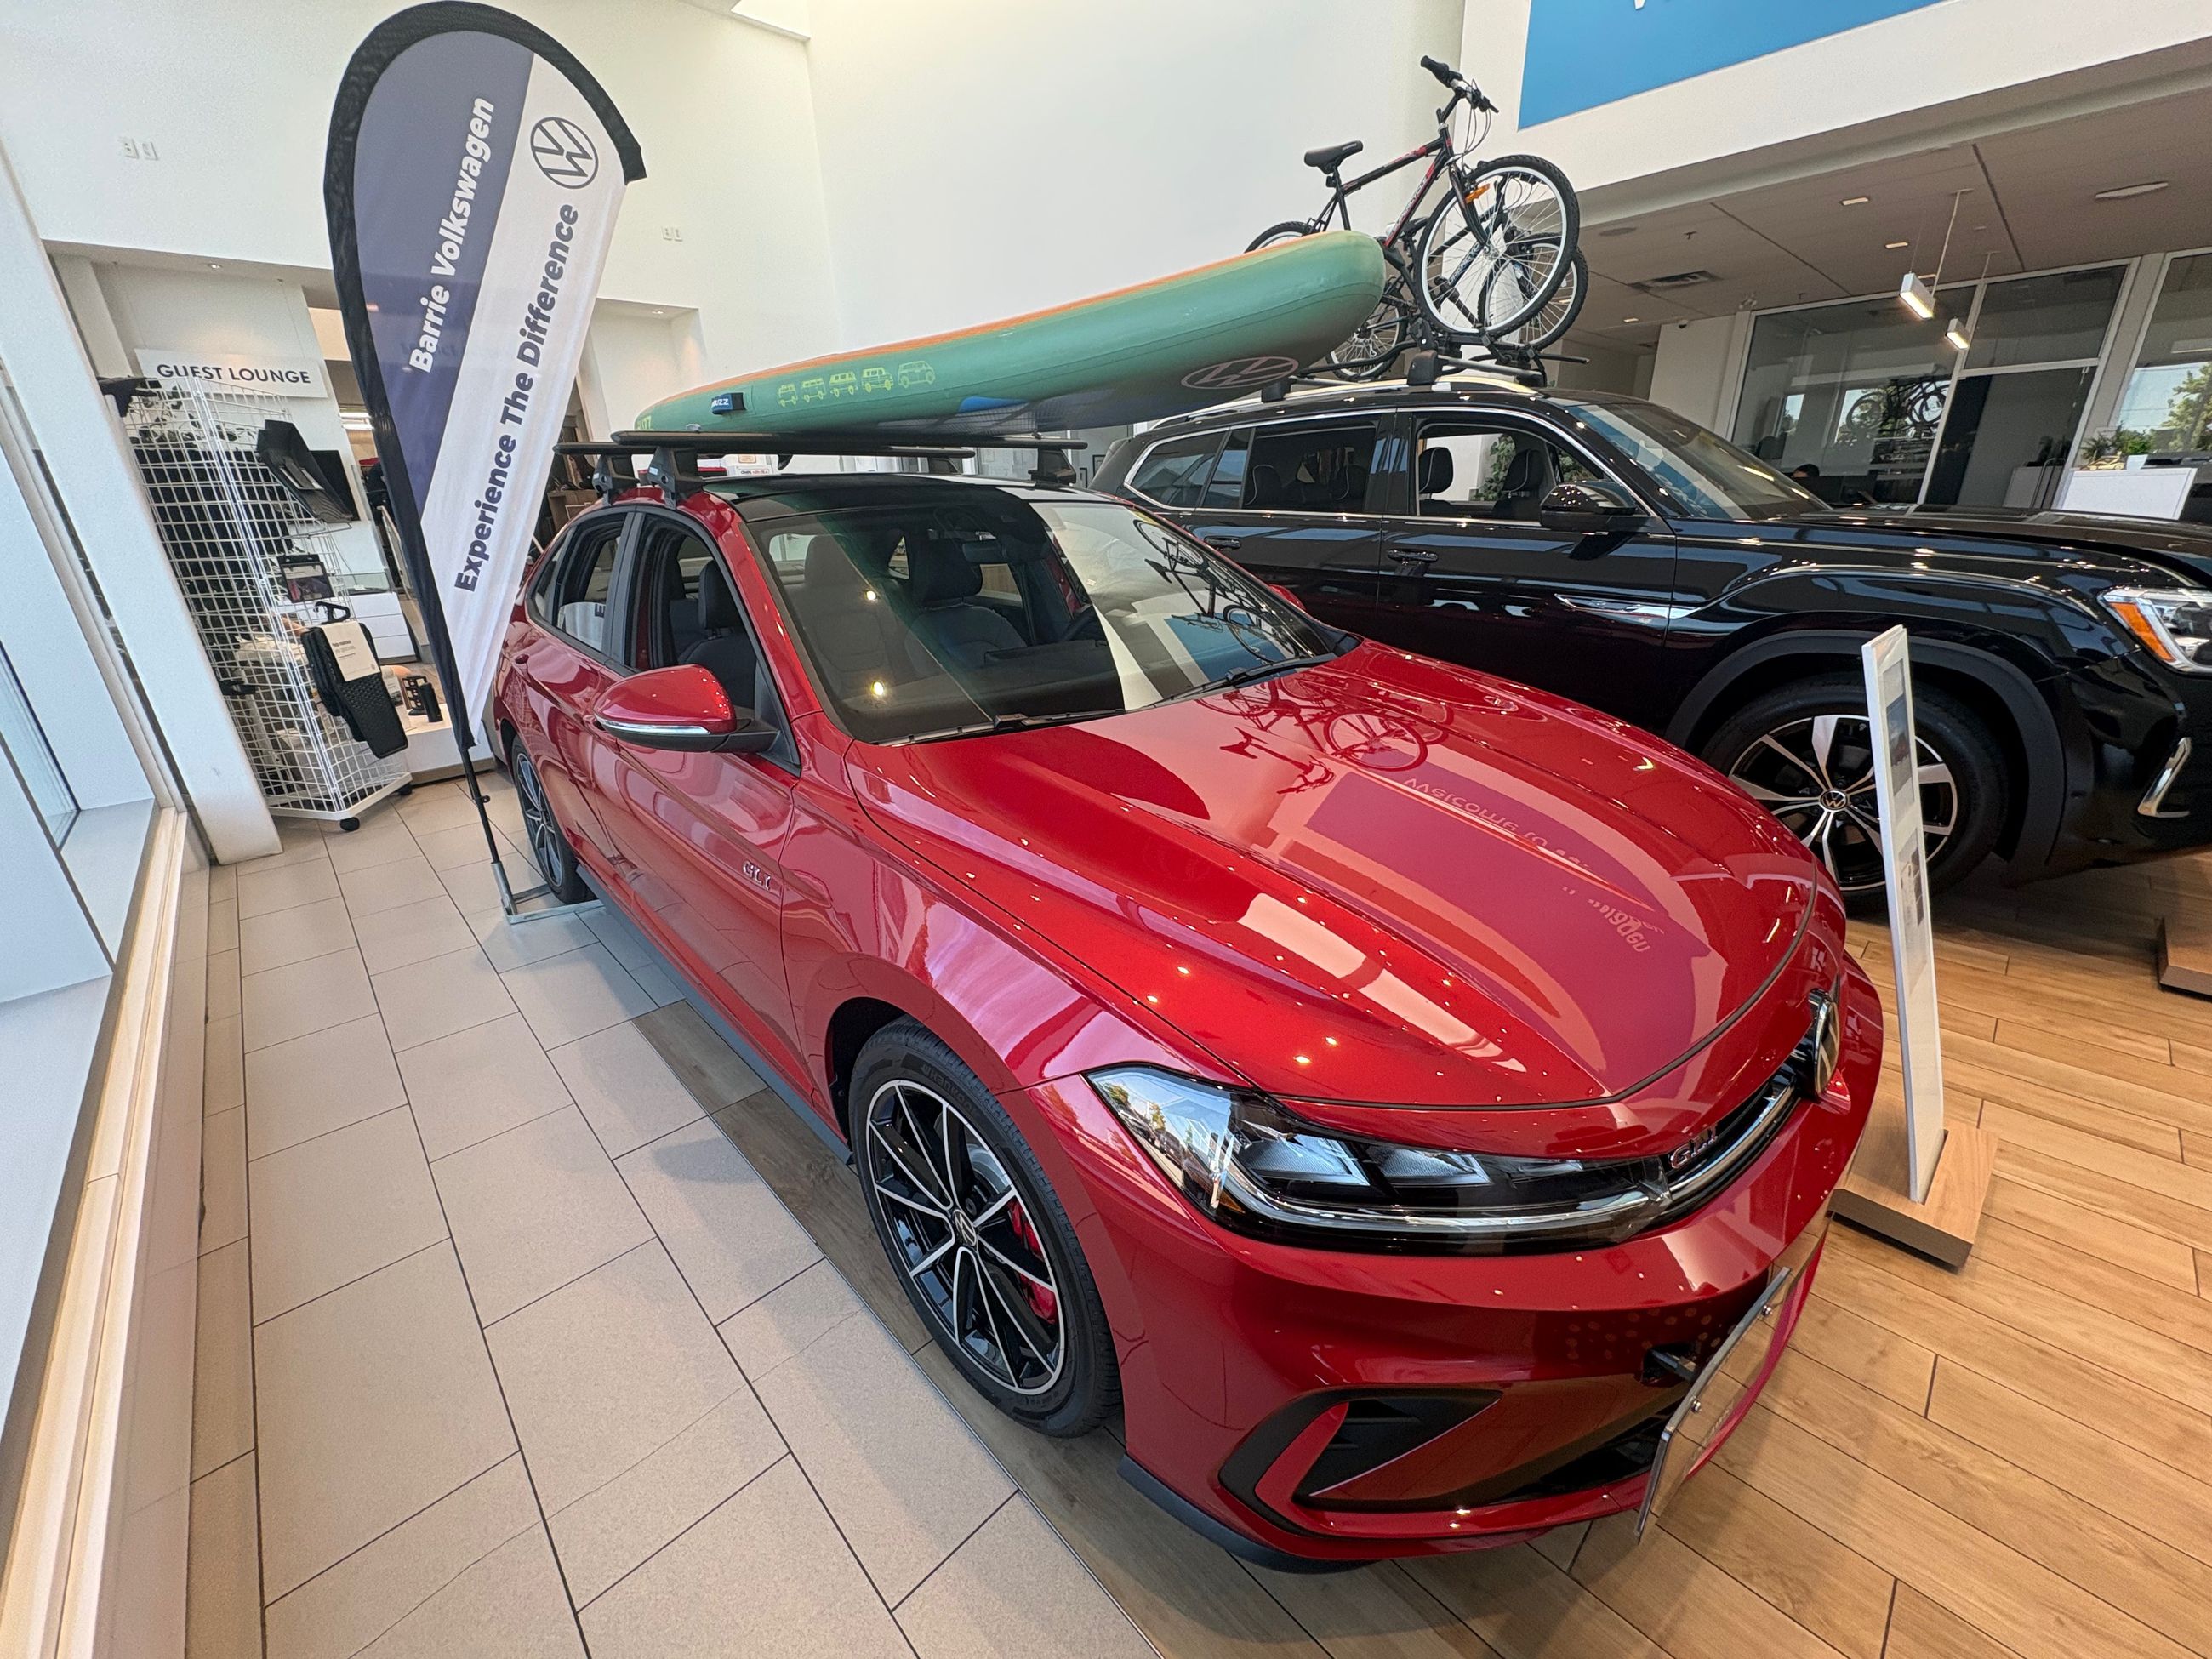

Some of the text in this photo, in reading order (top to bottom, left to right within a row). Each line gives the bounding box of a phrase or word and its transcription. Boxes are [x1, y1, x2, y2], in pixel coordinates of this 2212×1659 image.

[409, 97, 494, 373] Barrie Volkswagen
[157, 364, 311, 384] GUEST LOUNGE
[454, 203, 579, 592] Experience The Difference
[743, 860, 771, 891] GLI
